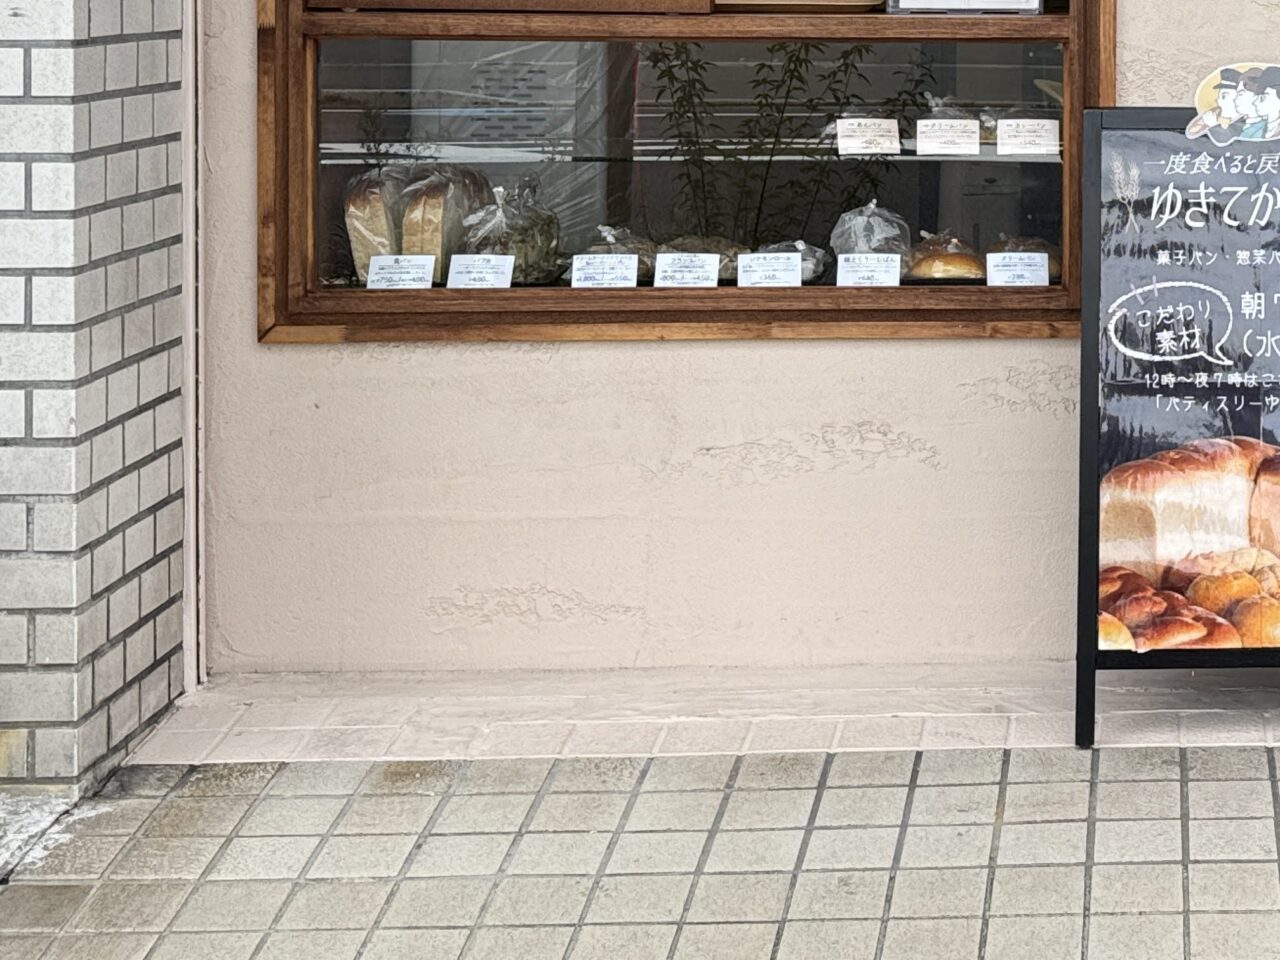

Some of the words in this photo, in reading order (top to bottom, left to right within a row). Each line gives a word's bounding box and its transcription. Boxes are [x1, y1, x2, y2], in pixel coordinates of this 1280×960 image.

[1135, 299, 1212, 328] こだわり
[1154, 326, 1201, 355] 素材
